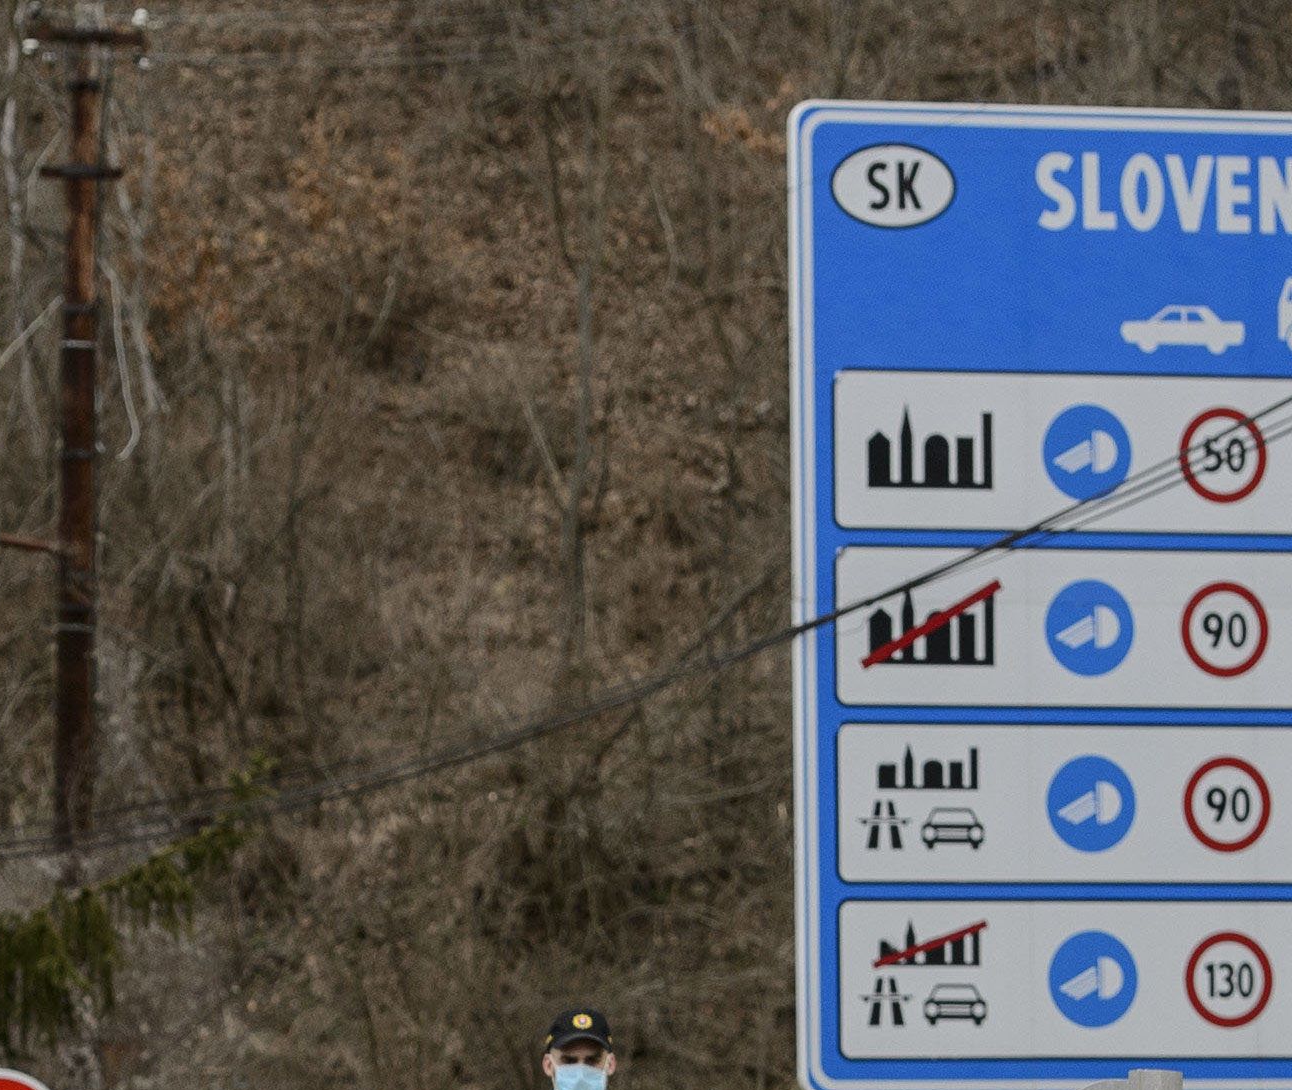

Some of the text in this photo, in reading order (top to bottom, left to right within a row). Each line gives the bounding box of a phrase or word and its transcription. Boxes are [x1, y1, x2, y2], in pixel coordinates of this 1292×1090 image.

[867, 161, 922, 211] SK
[1204, 437, 1247, 473] 50
[1202, 612, 1248, 649] 90
[1206, 786, 1251, 824] 90
[1206, 962, 1255, 999] 130
